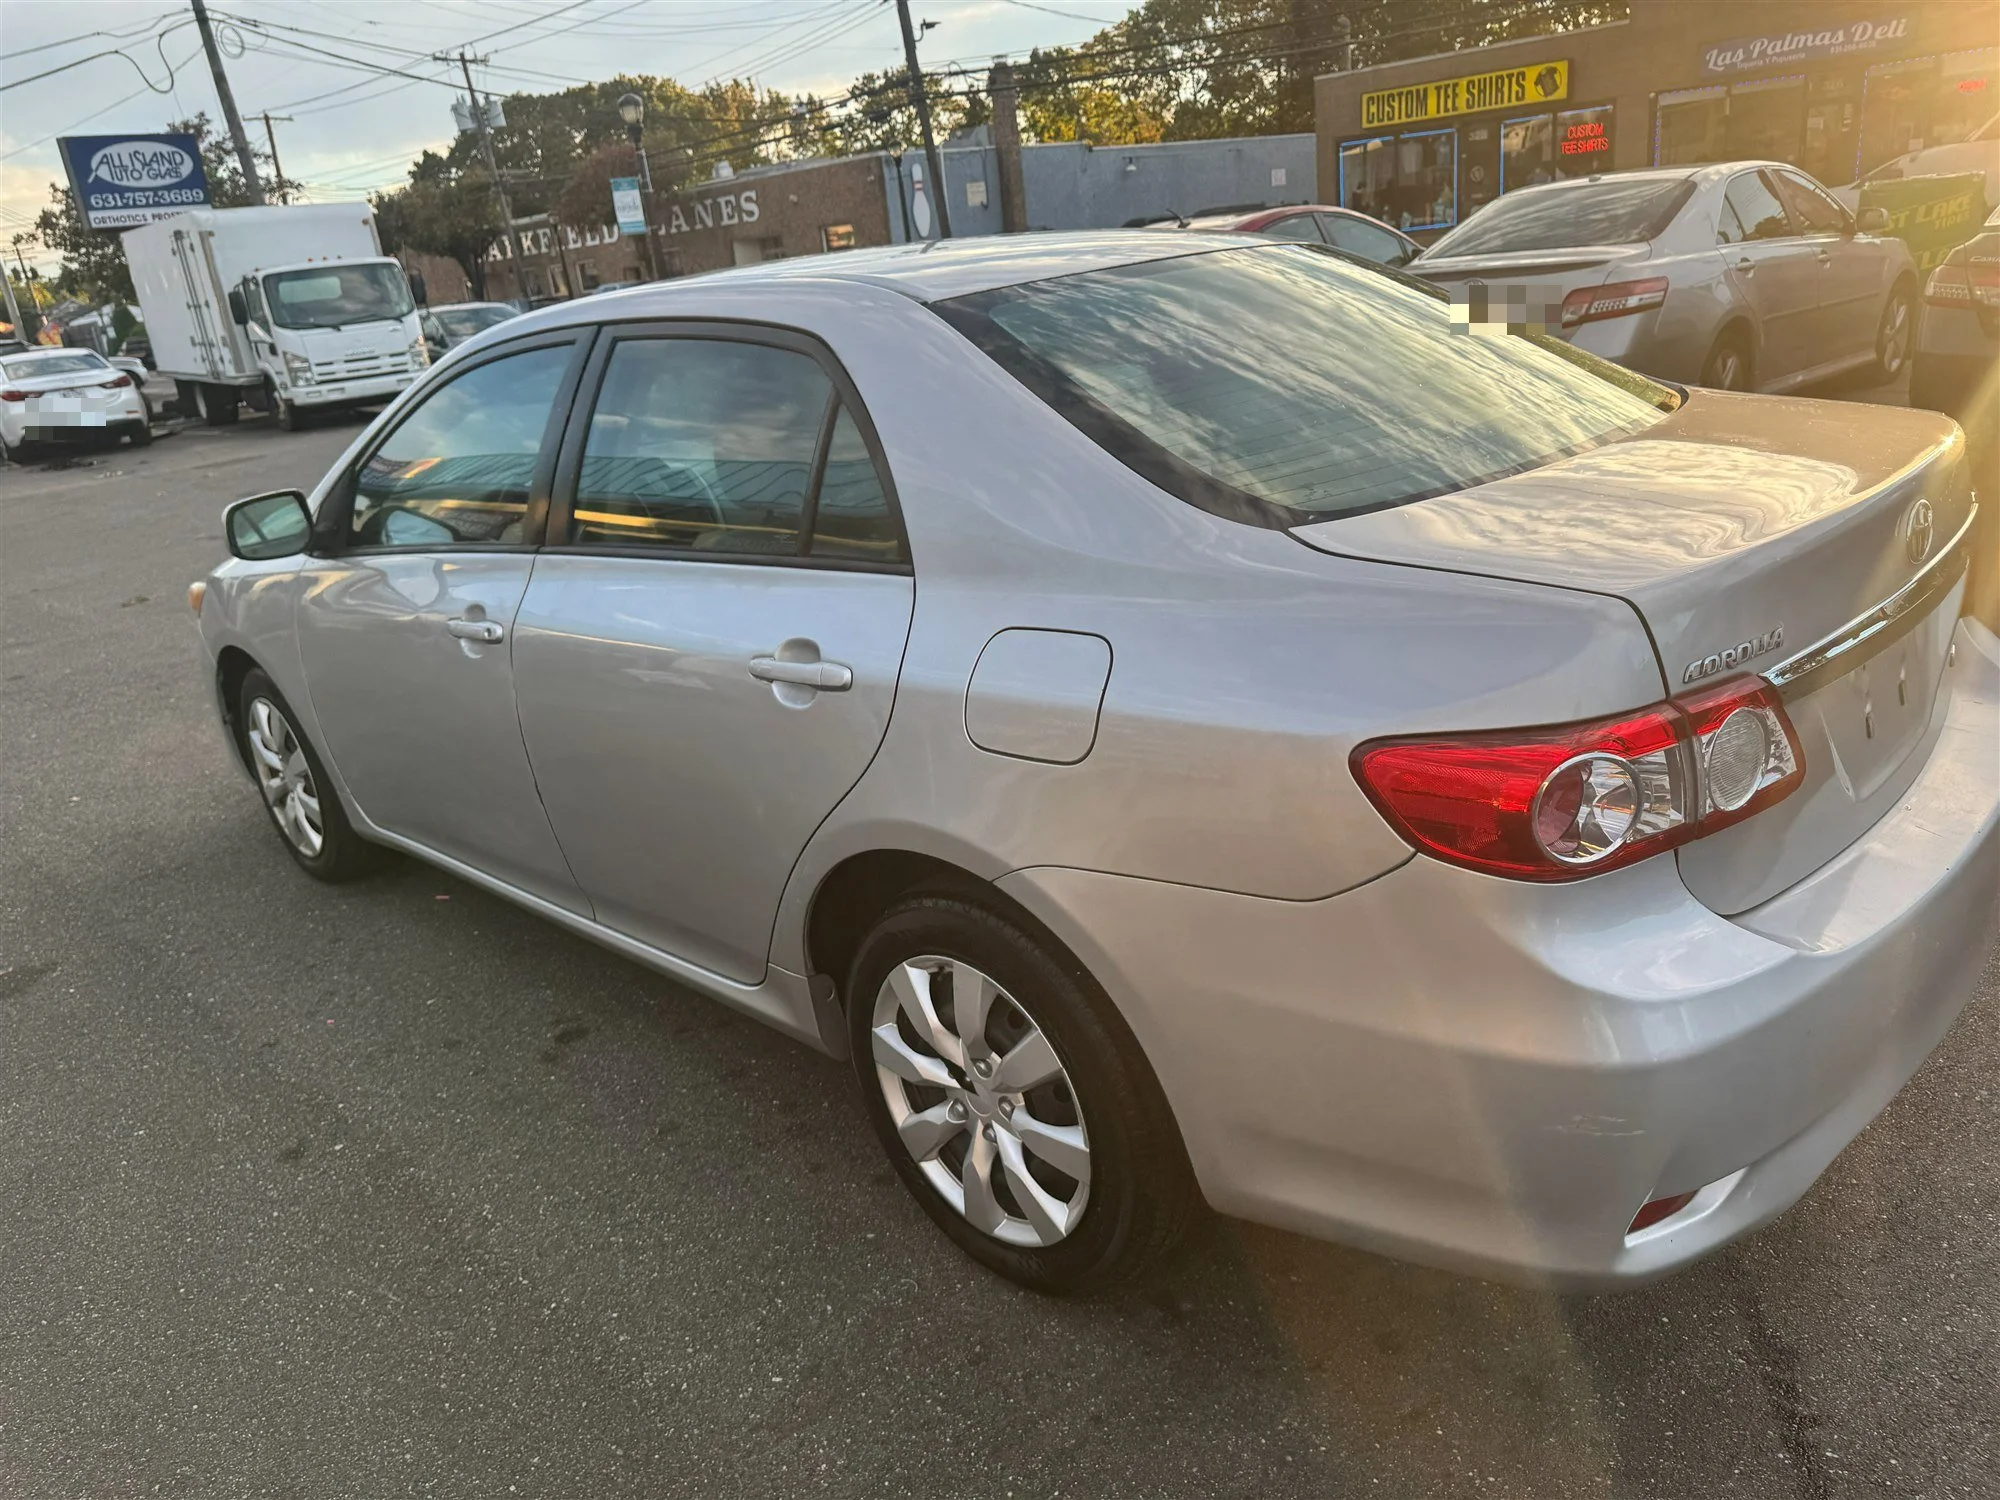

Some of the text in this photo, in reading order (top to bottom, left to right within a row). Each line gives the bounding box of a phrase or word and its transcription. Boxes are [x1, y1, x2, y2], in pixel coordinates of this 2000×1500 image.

[1706, 19, 1908, 72] Las Palmas Deli
[1366, 71, 1526, 125] CUSTOM TEE SHIRTS
[1567, 122, 1604, 140] CUSTOM
[1561, 137, 1609, 155] TEE SHIRTS
[92, 150, 185, 178] ALL ISLAND
[90, 188, 205, 208] 631-757-3689
[657, 189, 760, 236] ANES
[1915, 193, 1973, 224] LAKE
[93, 213, 149, 225] ORTHOTICS
[1683, 627, 1784, 684] COROLLA
